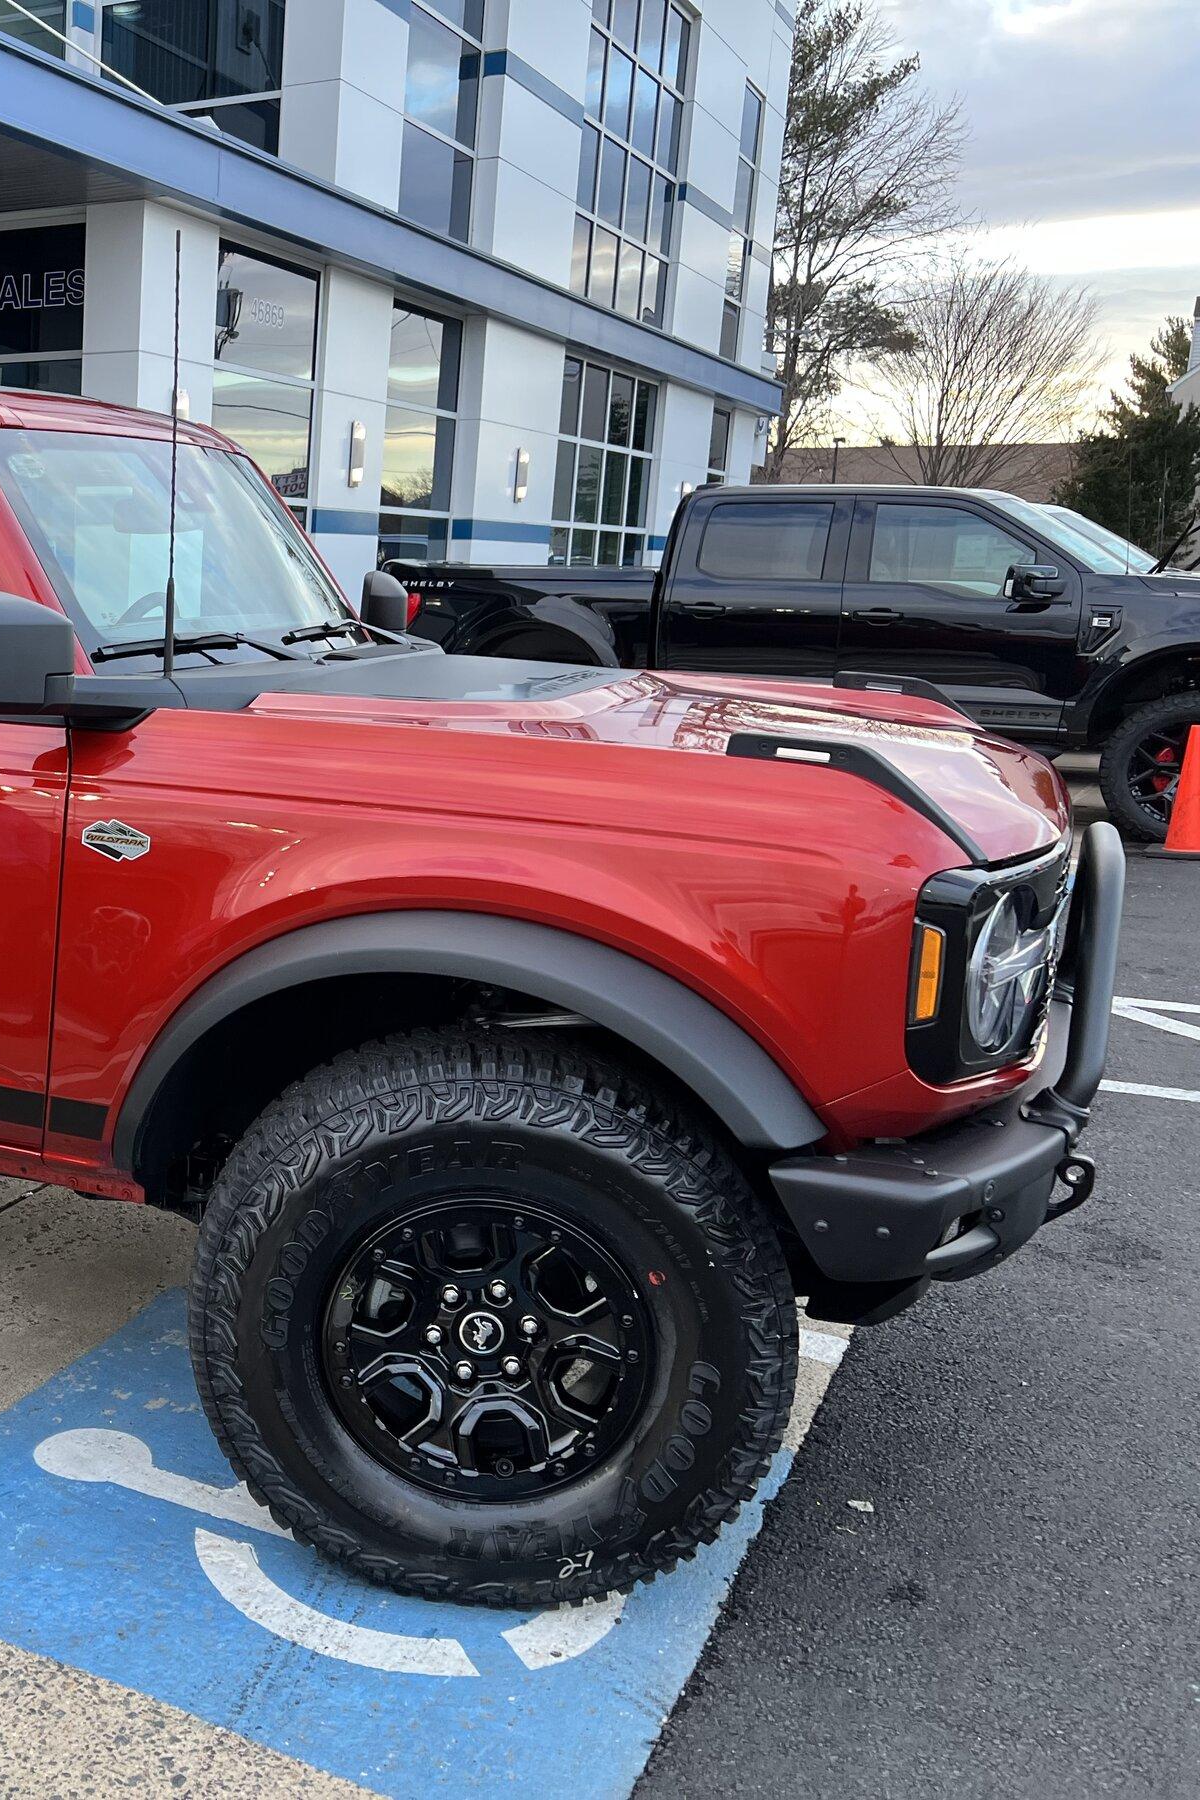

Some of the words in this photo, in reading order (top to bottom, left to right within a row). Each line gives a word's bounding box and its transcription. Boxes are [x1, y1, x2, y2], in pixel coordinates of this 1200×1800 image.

[401, 580, 455, 588] SHELBY
[980, 708, 1052, 720] SHELBY
[86, 832, 146, 848] WILDTRAK
[556, 1550, 595, 1579] 27
